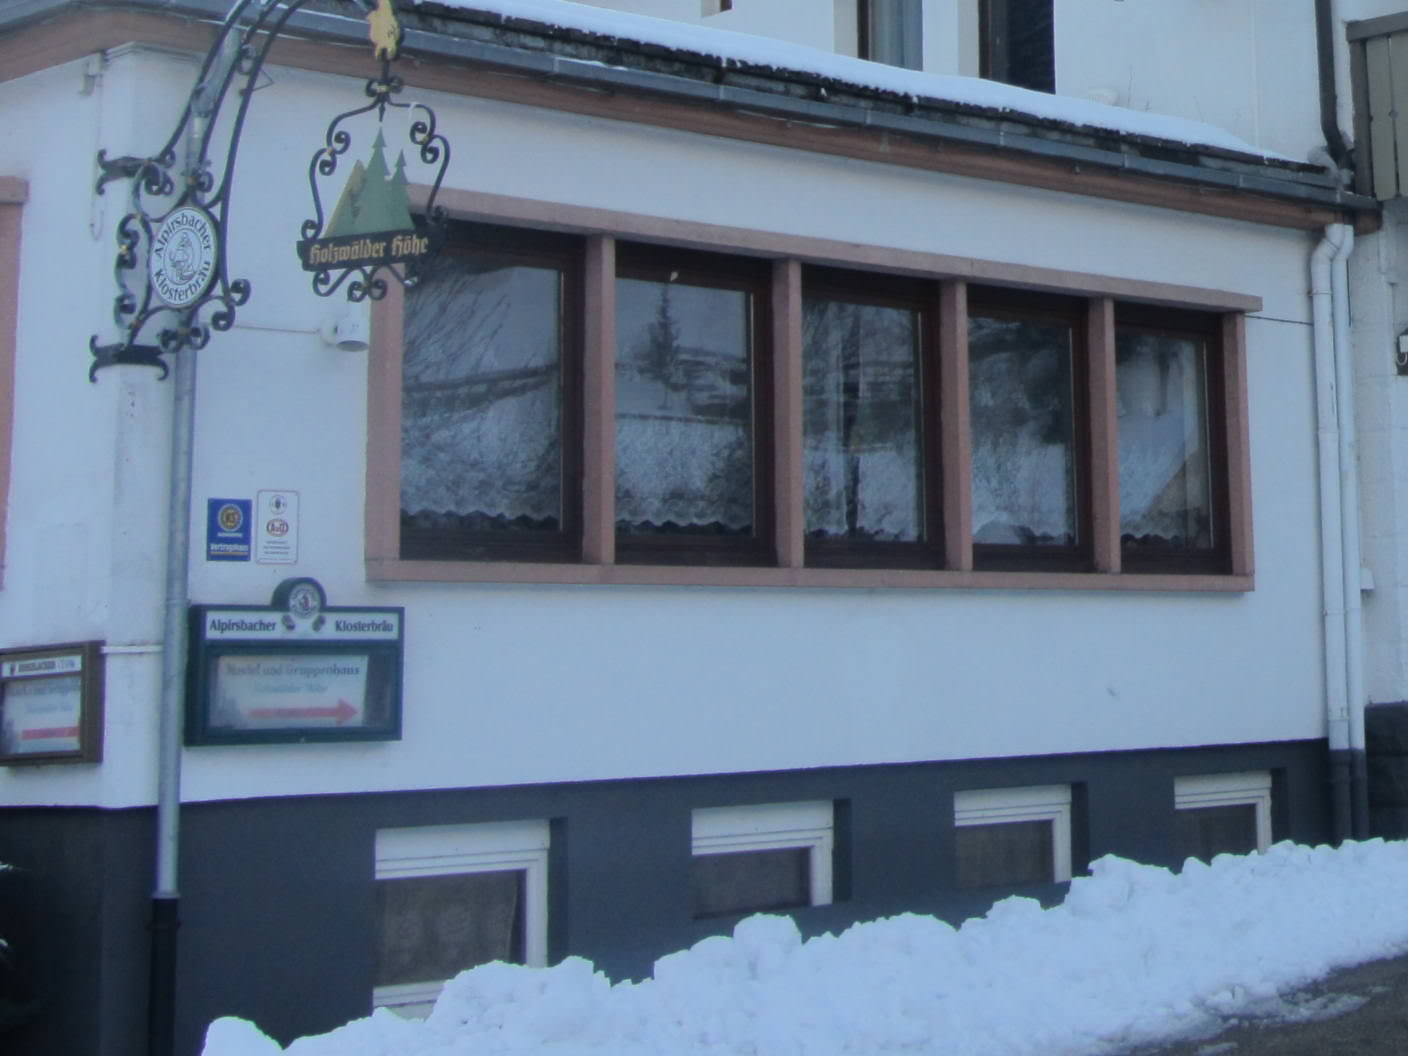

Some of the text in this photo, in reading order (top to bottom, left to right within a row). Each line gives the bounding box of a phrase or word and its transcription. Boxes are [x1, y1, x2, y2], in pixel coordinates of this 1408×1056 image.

[154, 213, 212, 258] Alpirsbacher
[309, 233, 429, 265] Holzwälder Höhe
[153, 260, 211, 302] Klosterbräu
[209, 618, 394, 634] Alpirsbacher Klosterbräu
